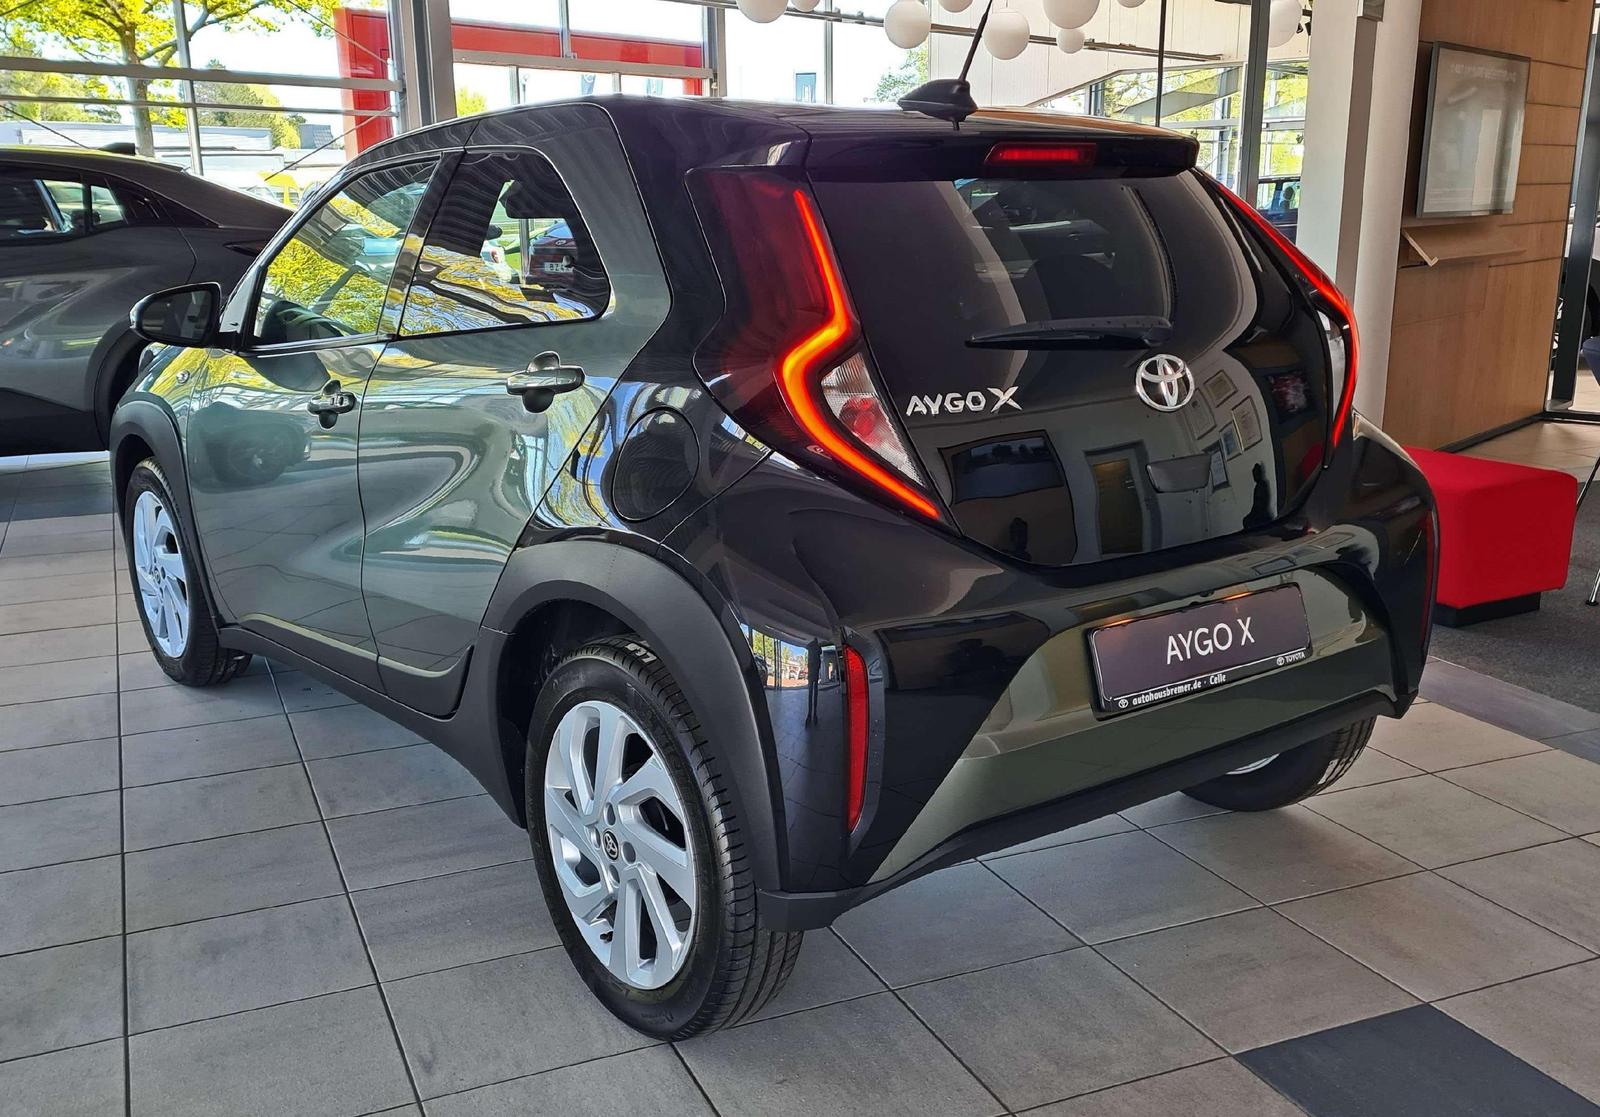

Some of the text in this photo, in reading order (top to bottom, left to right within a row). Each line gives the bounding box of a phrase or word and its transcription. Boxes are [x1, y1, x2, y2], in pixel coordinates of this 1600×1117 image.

[906, 386, 1022, 416] AYGO X
[1166, 617, 1255, 665] AYGO X
[1285, 651, 1306, 663] TOYOTA
[1132, 674, 1227, 706] autohausbremer.de Celle
